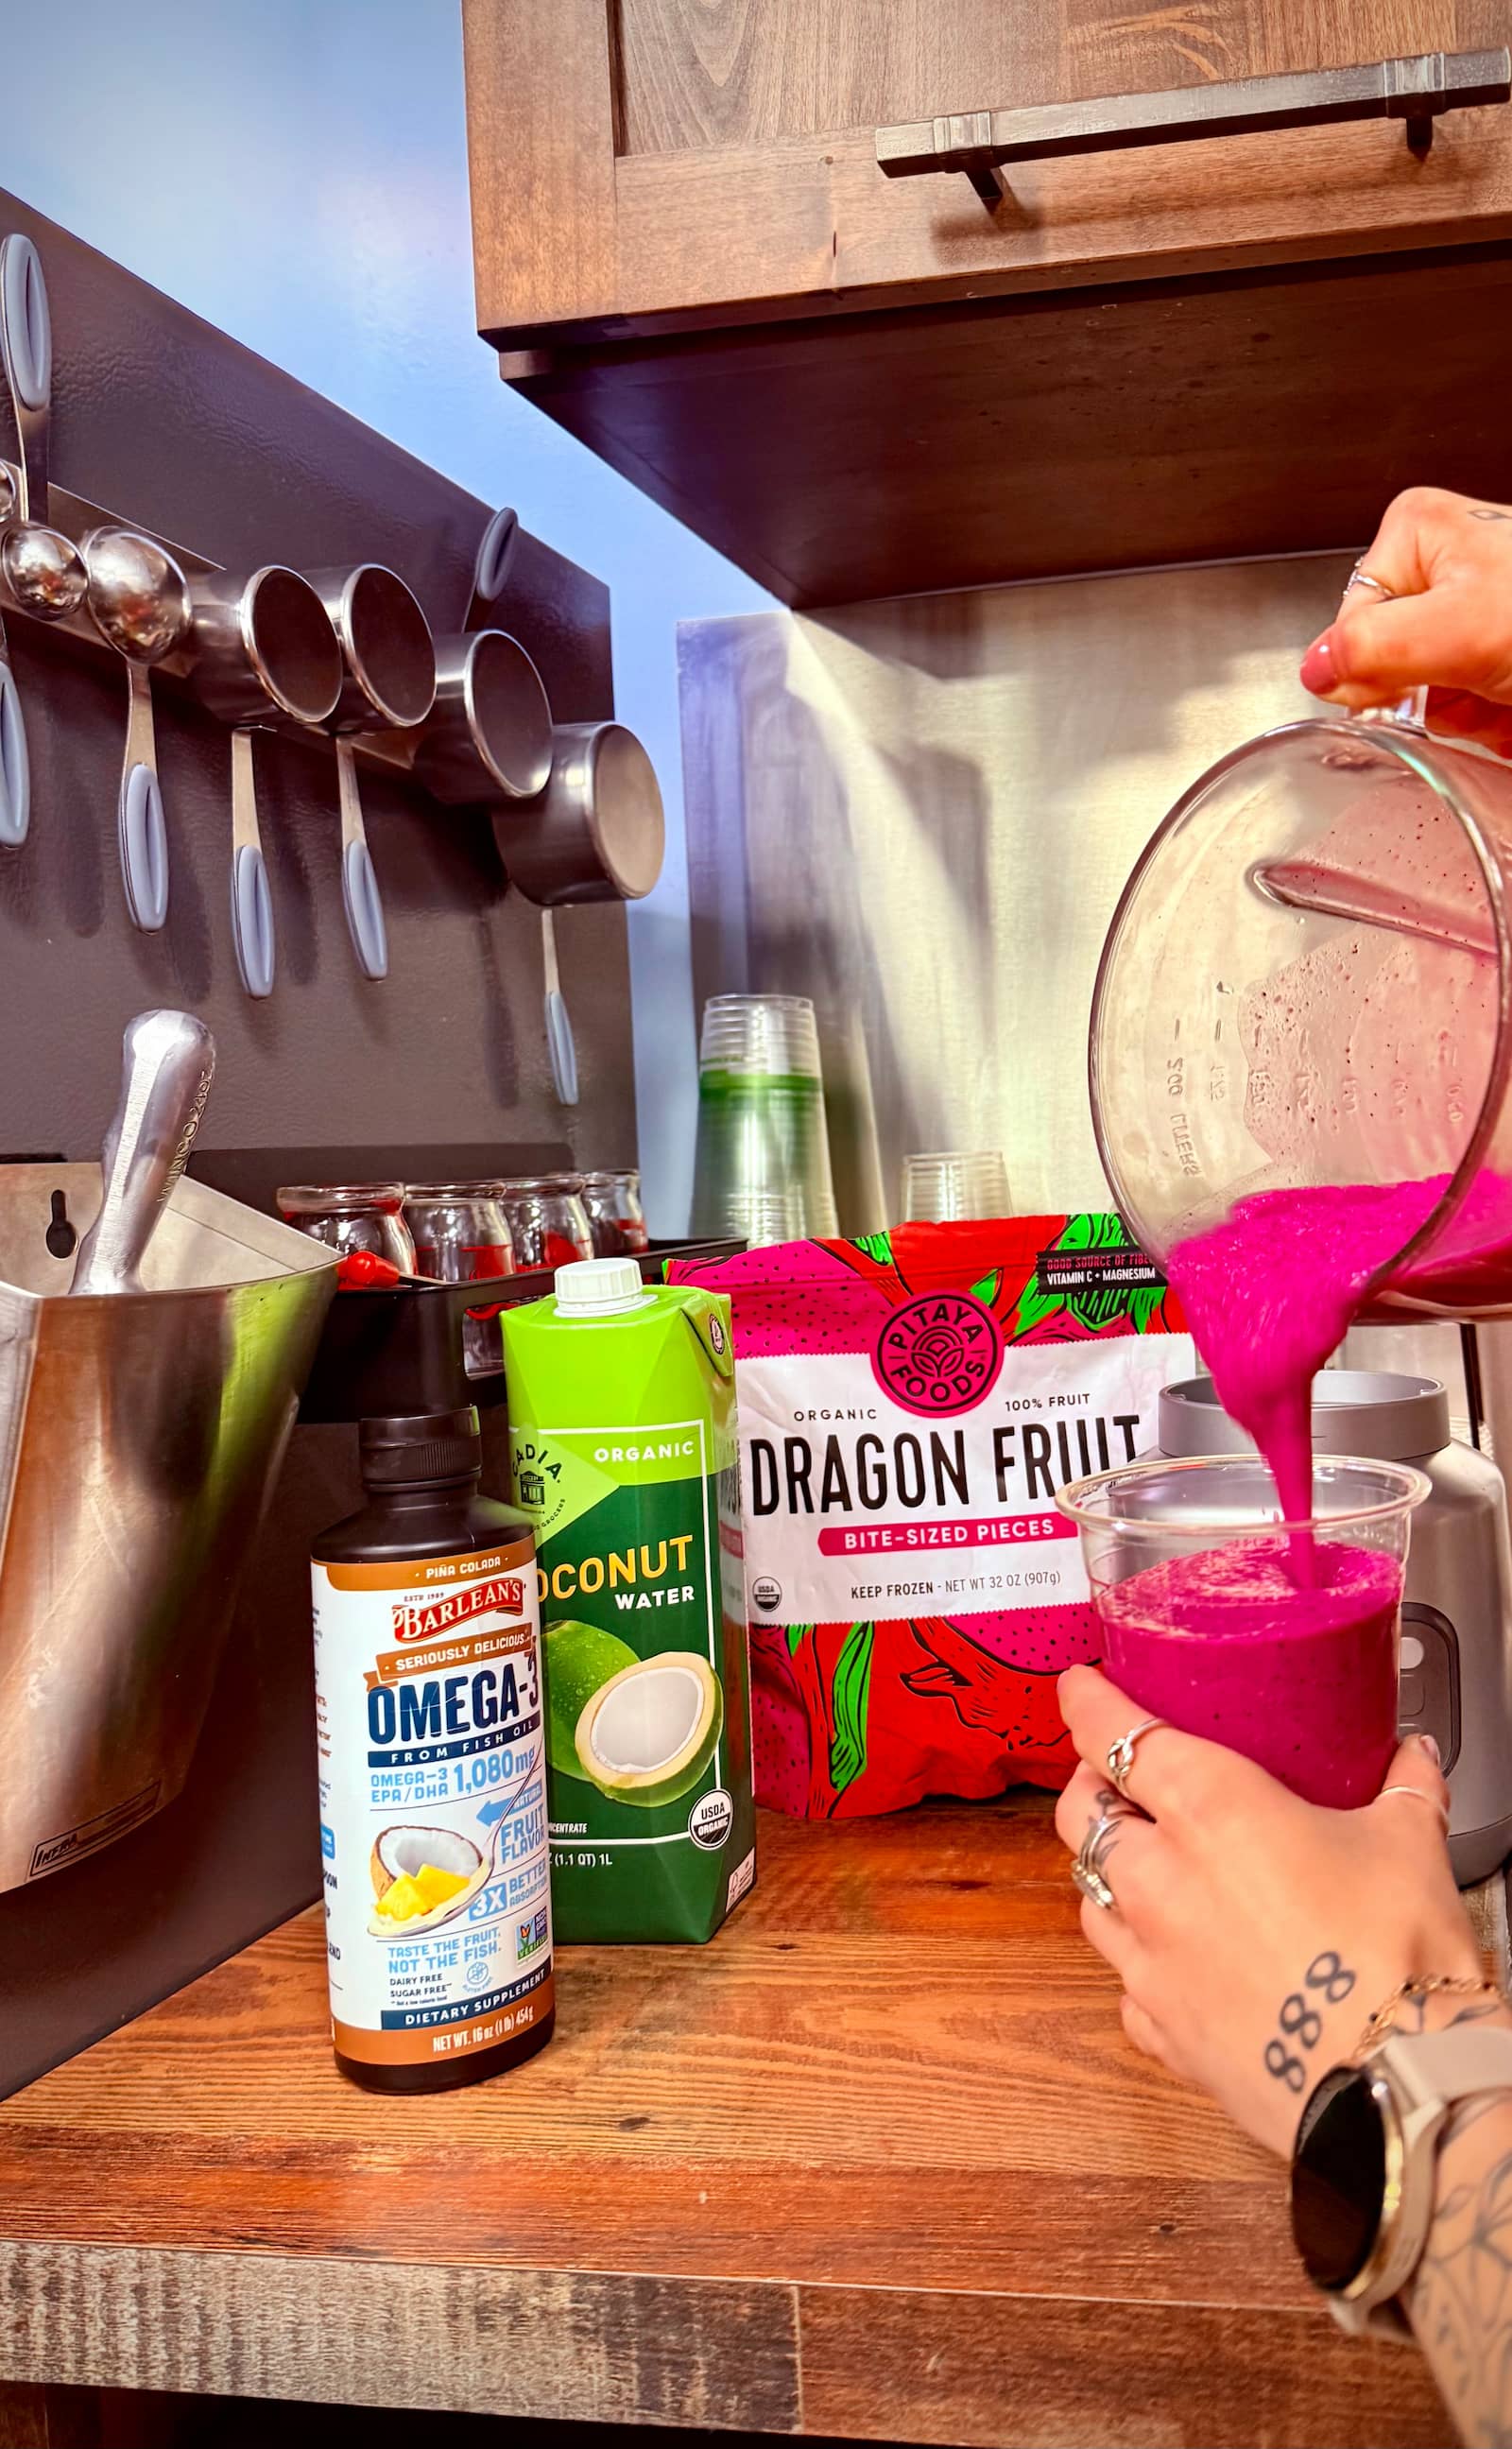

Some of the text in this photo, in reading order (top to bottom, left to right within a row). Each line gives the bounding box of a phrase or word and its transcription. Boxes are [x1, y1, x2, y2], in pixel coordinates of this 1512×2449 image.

[1047, 1258, 1072, 1270] GOOD
[1075, 1255, 1111, 1268] SOURCE
[1115, 1254, 1126, 1266] OF
[1047, 1268, 1157, 1285] VITAMIN C MAGNESIUM
[888, 1302, 984, 1350] PITAYA
[890, 1361, 986, 1403] FOODS
[1005, 1393, 1091, 1411] 100% FRUIT
[793, 1408, 878, 1422] ORGANIC
[593, 1440, 695, 1462] ORGANIC
[749, 1429, 970, 1516] DRAGON
[844, 1518, 1055, 1550] BITE-SIZED PIECES
[426, 1556, 501, 1579] PIÑA COLADA
[614, 1585, 695, 1610] WATER
[850, 1571, 1061, 1600] KEEP FROZEN NET WT 32 OZ (907g)
[393, 1579, 521, 1640] BARLEAN'S
[396, 1632, 525, 1671] SERIOUSLY DELICIOUS
[368, 1652, 540, 1745] OMEGA-3
[391, 1721, 533, 1765] FROM FISH OIL
[370, 1767, 449, 1788] OMEGA-3
[370, 1783, 449, 1803] EPA/DHA
[701, 1802, 725, 1820] USDA
[501, 1803, 543, 1847] FRUIT
[697, 1815, 729, 1837] ORGANIC
[555, 1853, 575, 1868] (1.1
[577, 1852, 596, 1869] QT)
[599, 1853, 613, 1866] 1L
[472, 1886, 505, 1918] 3X
[387, 1944, 430, 1958] TASTE
[434, 1939, 460, 1954] THE
[388, 1958, 422, 1974] NOT
[426, 1952, 459, 1970] THE
[389, 1973, 443, 1987] DAIRY FREE
[390, 1989, 421, 1997] SUGAR
[405, 1968, 545, 2026] DIETARY SUPPLEMENT
[1263, 1949, 1357, 2095] 888
[433, 2034, 453, 2053] NET
[454, 2029, 472, 2049] WT.
[472, 2026, 483, 2044] 16
[484, 2026, 494, 2040] oz
